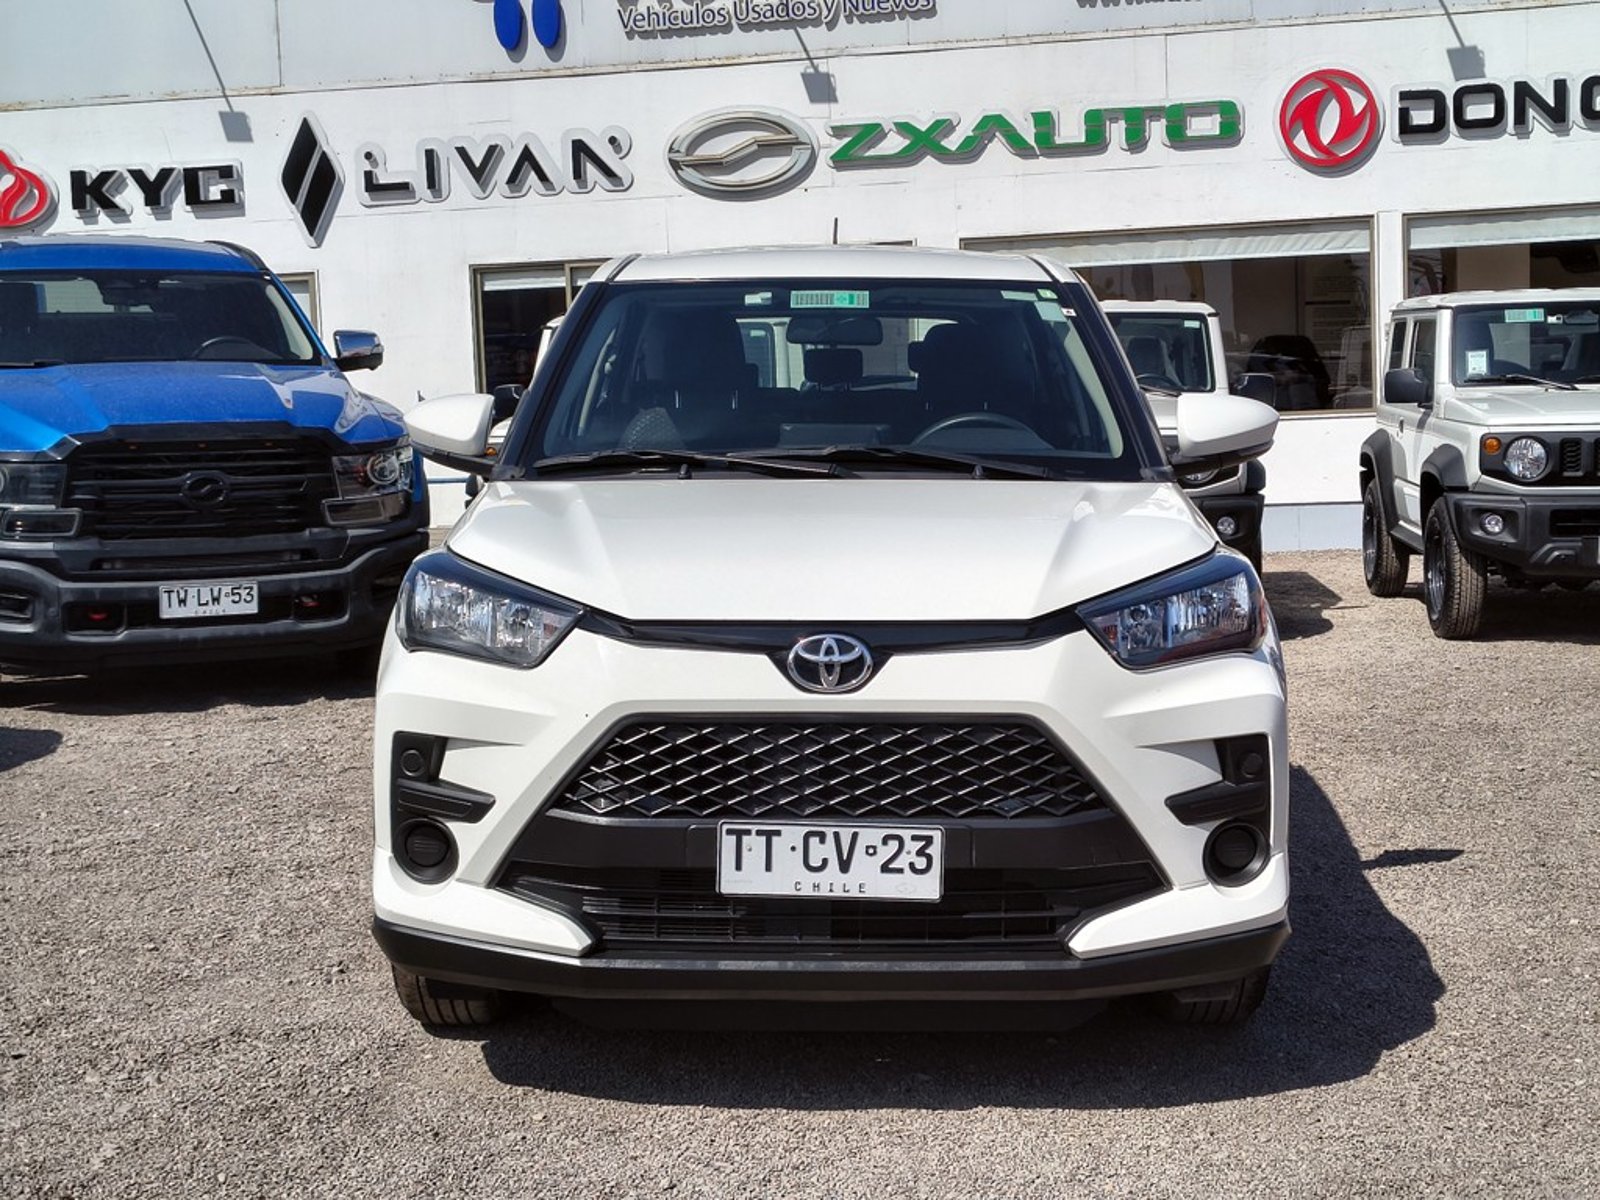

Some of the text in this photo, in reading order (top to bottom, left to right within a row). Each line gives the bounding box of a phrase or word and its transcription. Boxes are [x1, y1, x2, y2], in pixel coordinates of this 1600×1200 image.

[617, 3, 728, 29] Vehículos
[733, 0, 817, 22] Usados
[822, 0, 836, 19] y
[829, 100, 1241, 162] ZXAUTO
[70, 164, 236, 211] KYC
[364, 136, 623, 193] LIVAN
[794, 881, 866, 894] CHILE
